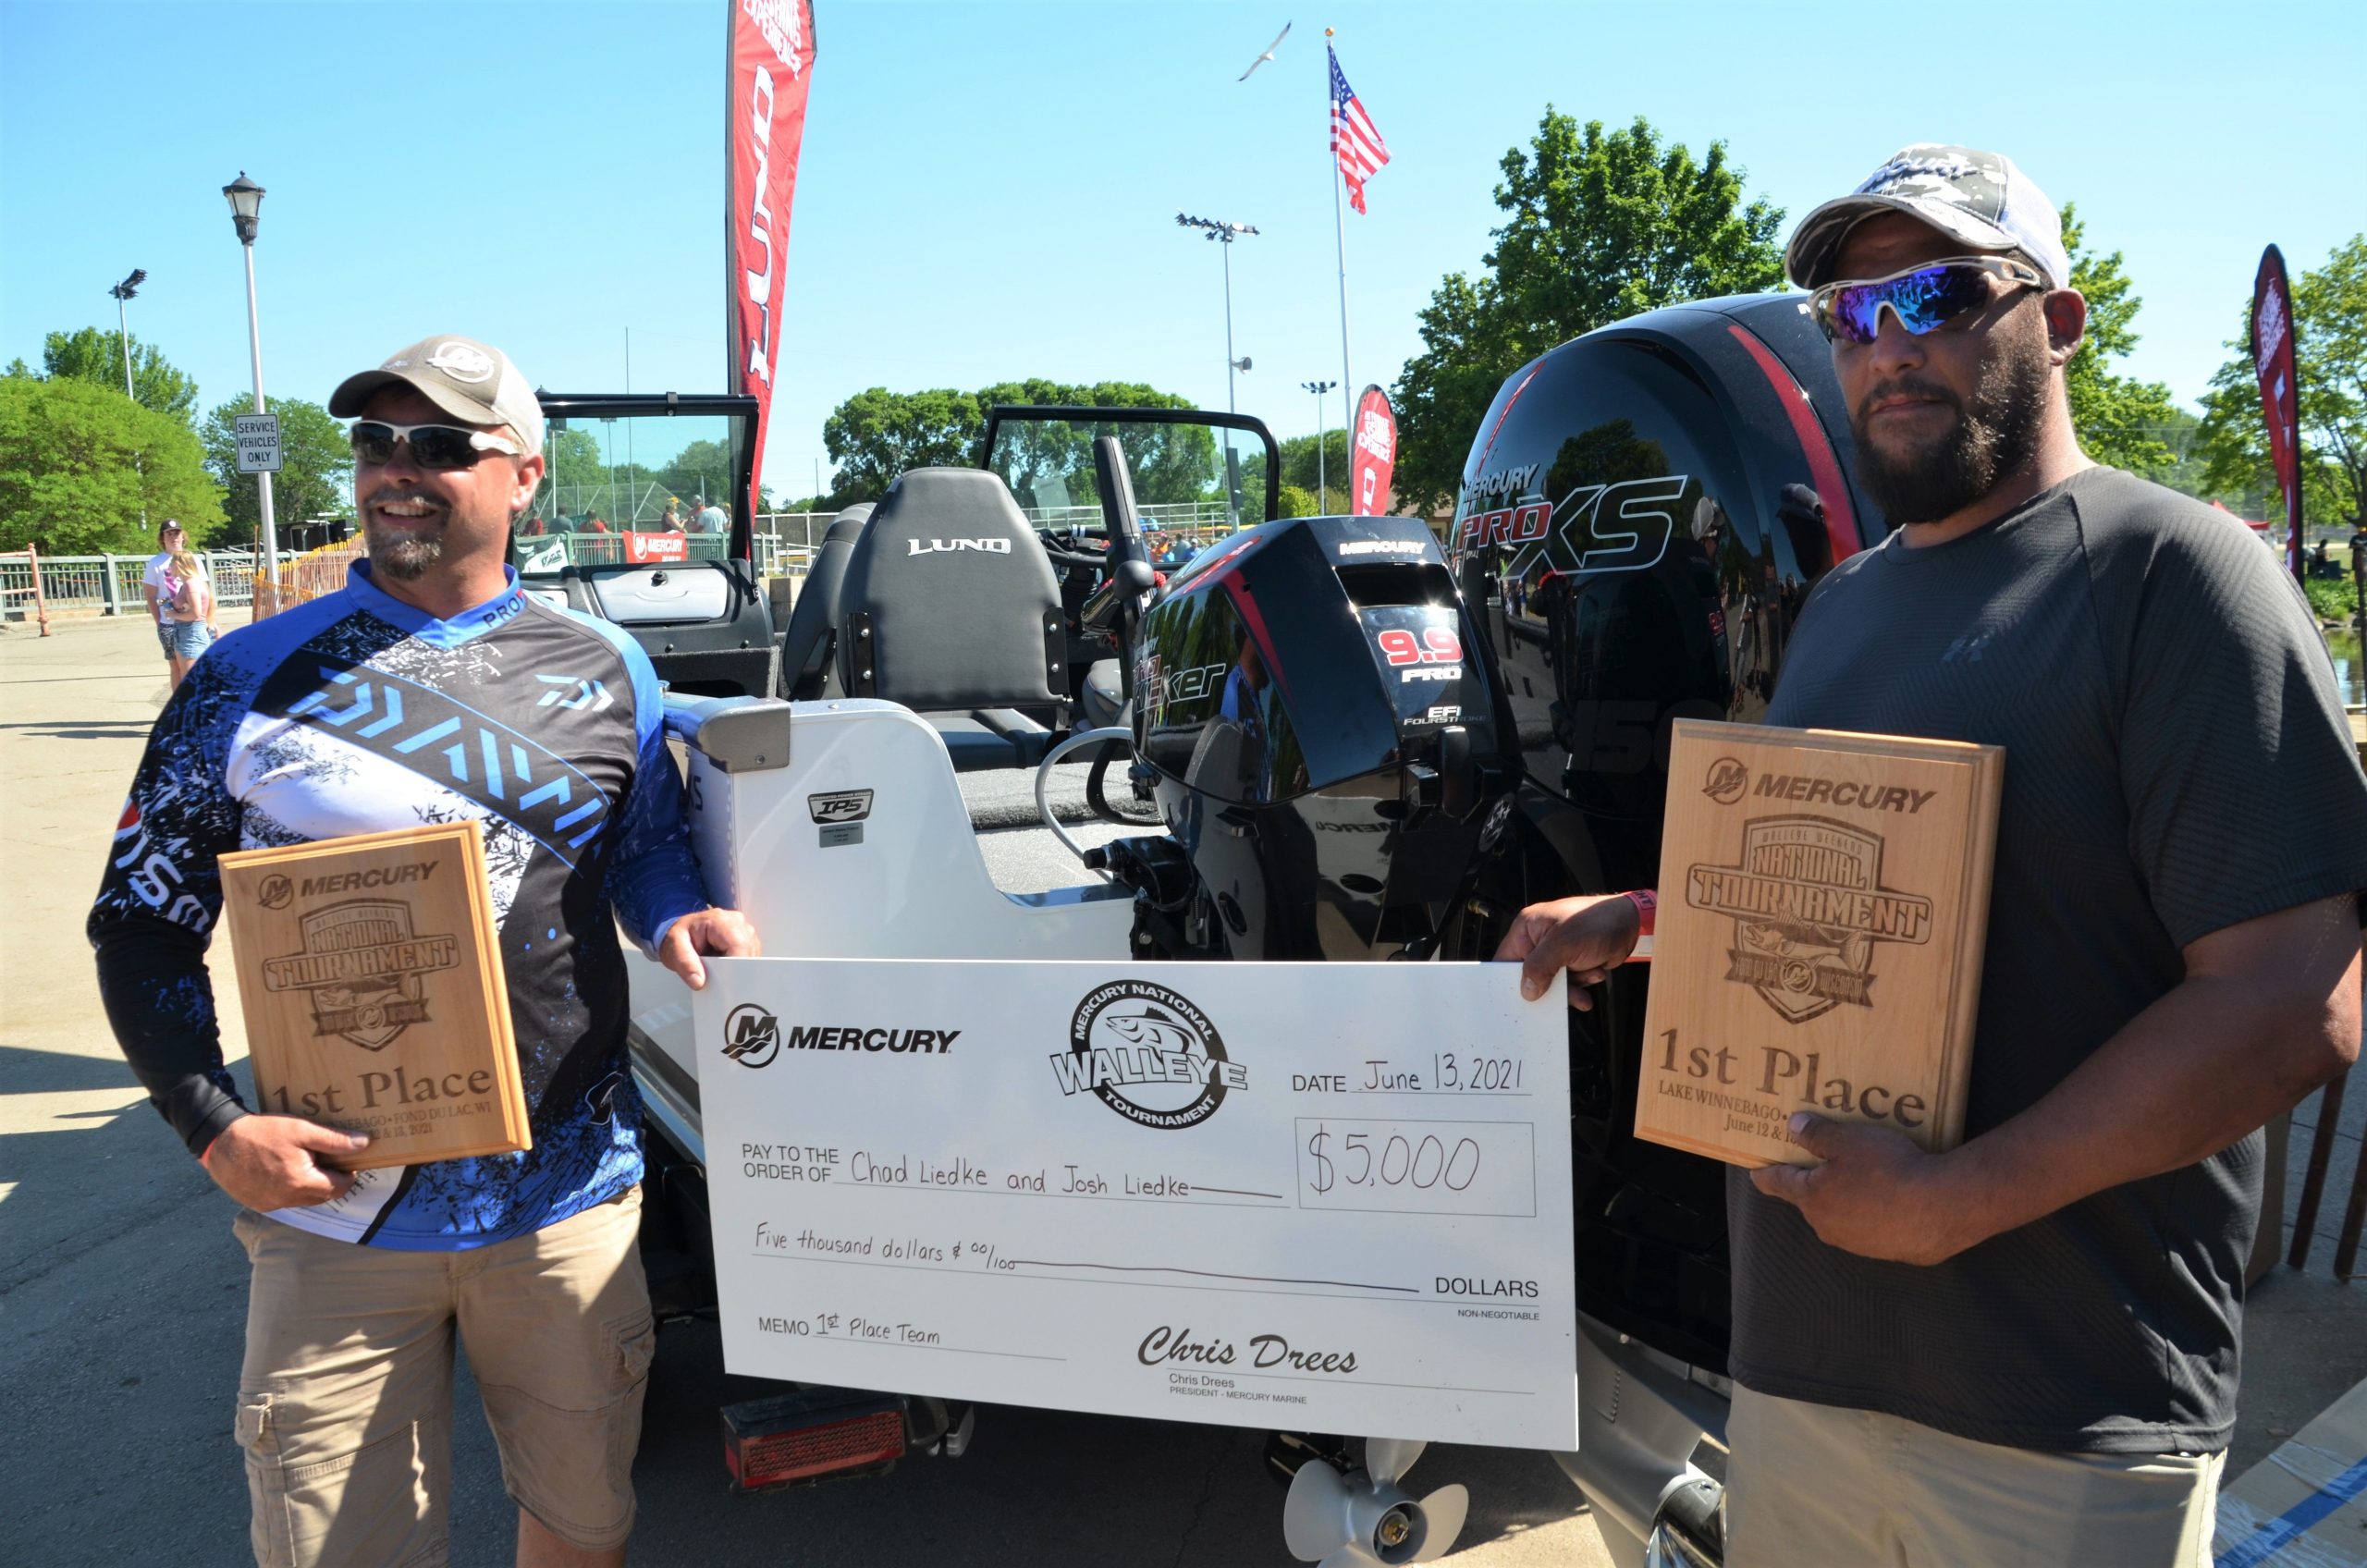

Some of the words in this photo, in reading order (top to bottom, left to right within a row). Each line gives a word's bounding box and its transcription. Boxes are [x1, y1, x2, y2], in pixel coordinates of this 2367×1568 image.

[238, 422, 276, 434] SERVICE
[239, 436, 277, 448] VEHICLES
[247, 450, 270, 463] ONLY
[1463, 463, 1539, 499] MERCURY
[1456, 501, 1553, 554] PRO
[907, 537, 1012, 557] LUND
[1340, 541, 1426, 555] MERCURY
[1379, 626, 1464, 666] 9.9
[1402, 668, 1462, 682] PRO
[1428, 705, 1461, 718] EFI
[1753, 774, 1937, 814] MERCURY
[300, 861, 439, 897] MERCURY
[1752, 843, 1867, 890] NATIONAL
[1693, 870, 1929, 937] TOURNAMENT
[312, 919, 404, 952] NATIONAL
[266, 937, 454, 988] TOURNAMENT
[1075, 983, 1127, 1040] MERCURY
[1131, 983, 1214, 1041] NATIONAL
[788, 1025, 962, 1054] MERCURY
[1049, 1047, 1248, 1096] WALLEYE
[1292, 1074, 1347, 1092] DATE
[1364, 1060, 1422, 1091] June
[1660, 1028, 1738, 1084] 1st
[1756, 1046, 1925, 1128] Place
[274, 1085, 344, 1117] 1st
[357, 1065, 491, 1109] Place
[1659, 1080, 1693, 1100] LAKE
[1696, 1088, 1781, 1121] WINNEBAGO
[394, 1109, 426, 1123] FOND
[430, 1107, 446, 1119] DU
[448, 1105, 473, 1118] LAC,
[476, 1101, 492, 1113] WI
[1104, 1090, 1217, 1126] TOURNAMENT
[410, 1122, 433, 1134] 2021
[1723, 1114, 1753, 1132] June
[1757, 1121, 1768, 1136] 12
[1772, 1125, 1782, 1140] &
[742, 1144, 772, 1160] PAY
[777, 1145, 800, 1162] TO
[804, 1146, 839, 1164] THE
[1308, 1122, 1479, 1195] $5,000
[743, 1162, 804, 1181] ORDER
[807, 1165, 831, 1182] OF
[852, 1150, 908, 1183] Chad
[920, 1156, 988, 1185] Liedke
[1006, 1165, 1045, 1194] and
[1061, 1164, 1108, 1194] Josh
[1124, 1167, 1190, 1197] Liedke
[755, 1221, 788, 1249] Five
[797, 1229, 873, 1256] thousand
[882, 1234, 943, 1262] dollars
[1435, 1277, 1539, 1298] DOLLARS
[758, 1317, 809, 1337] MEMO
[816, 1314, 840, 1335] 1st
[849, 1318, 890, 1340] Place
[897, 1324, 940, 1345] Team
[1457, 1309, 1539, 1321] NON-NEGOTIABLE
[1137, 1326, 1236, 1366] Chris
[1249, 1334, 1358, 1374] Drees
[1169, 1373, 1198, 1386] Chris
[1201, 1375, 1234, 1389] Drees
[1170, 1387, 1219, 1399] PRESIDENT
[1226, 1390, 1270, 1403] MERCURY
[1272, 1394, 1307, 1405] MARINE
